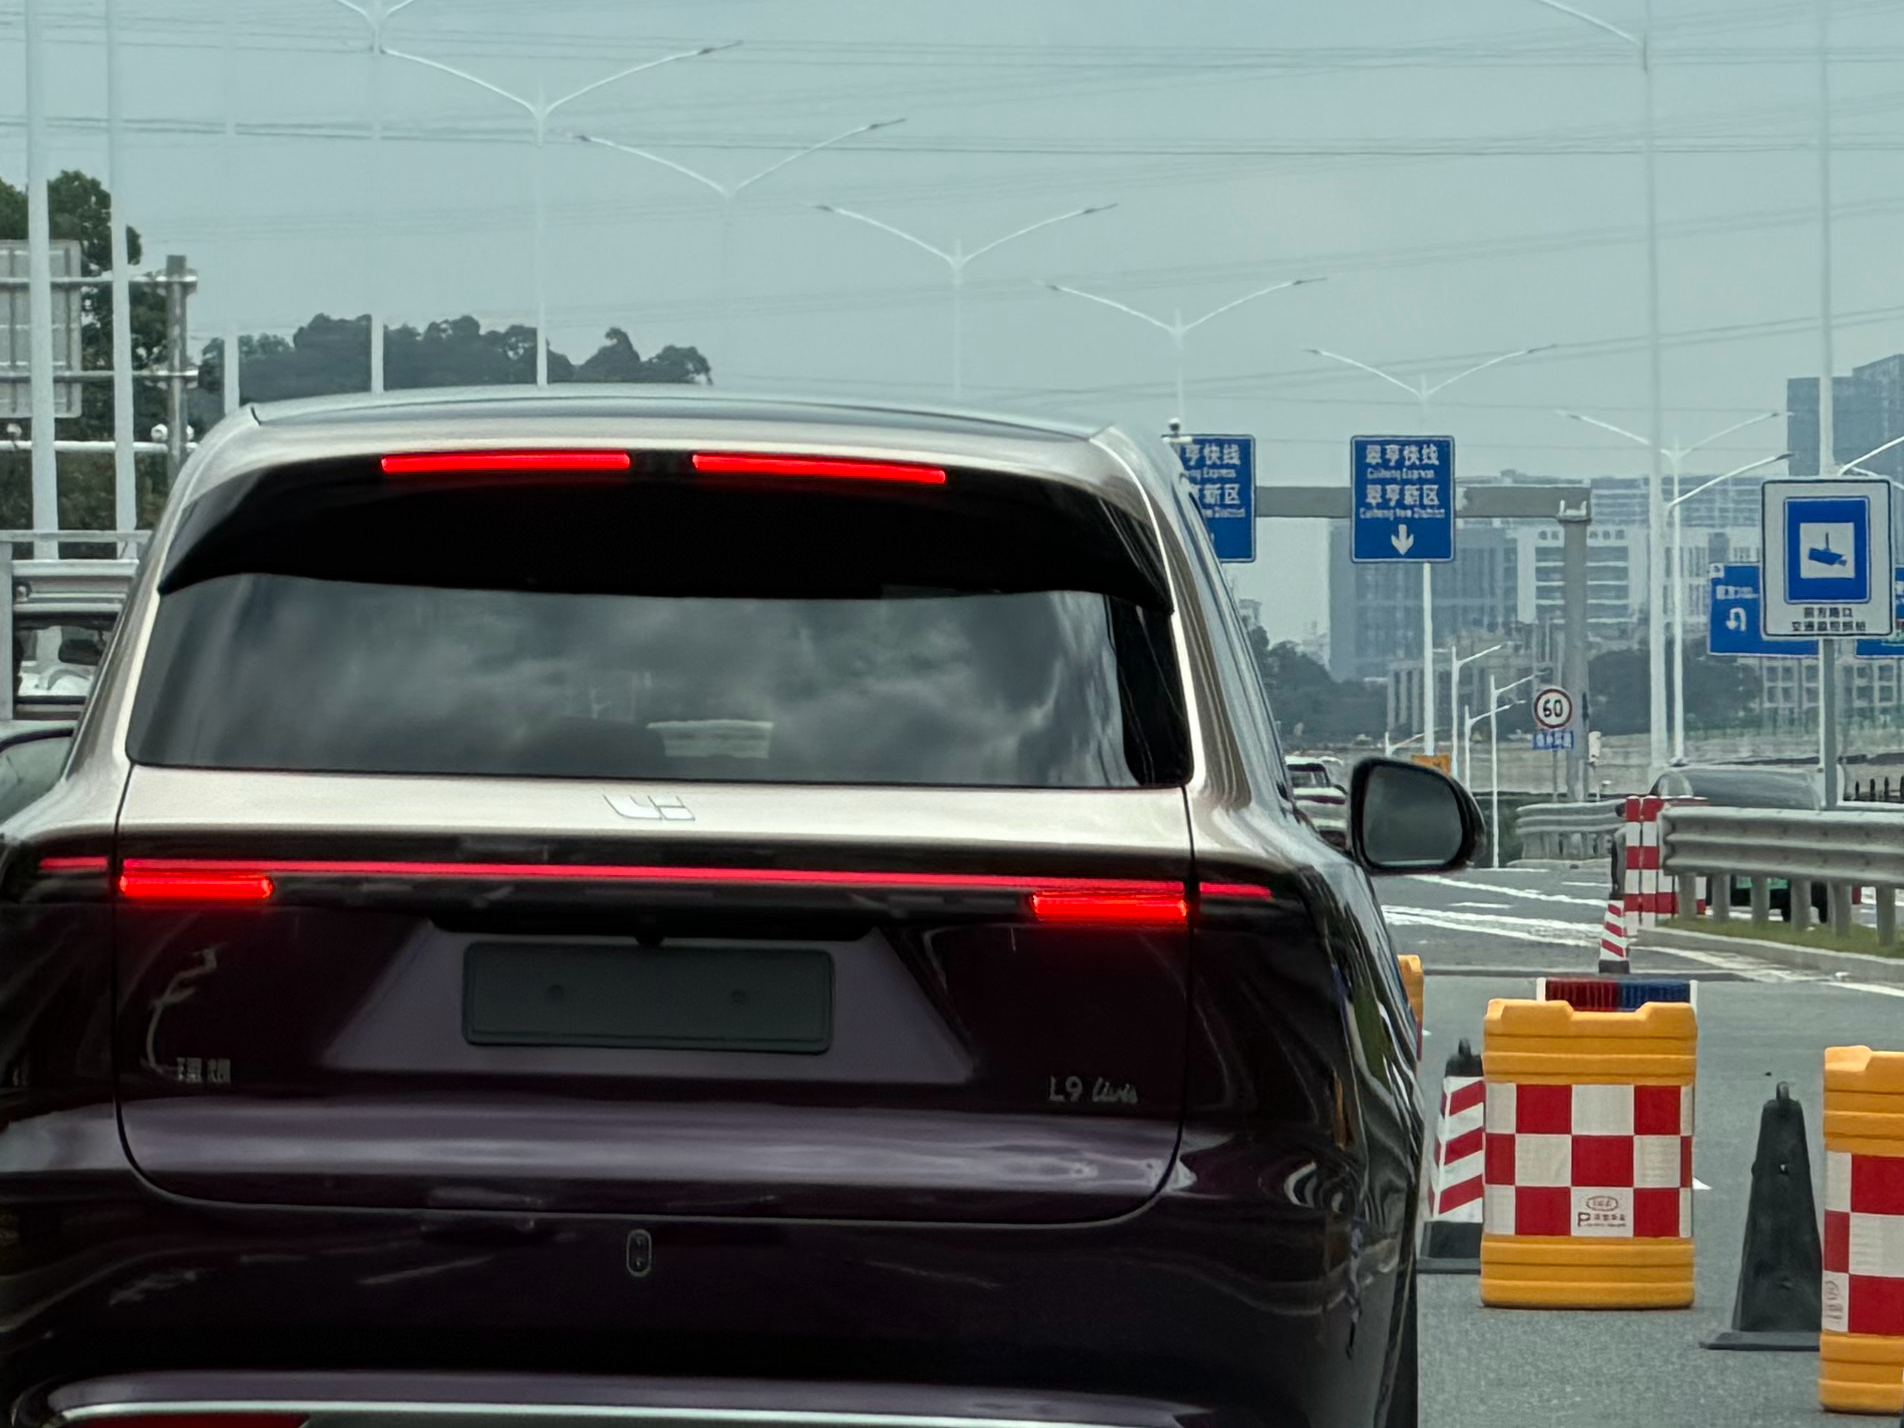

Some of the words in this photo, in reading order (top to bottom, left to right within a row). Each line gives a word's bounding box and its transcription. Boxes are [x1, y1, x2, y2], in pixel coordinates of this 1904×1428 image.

[1176, 443, 1241, 465] 亨快线
[1542, 698, 1563, 717] 60
[1049, 1075, 1084, 1103] L9
